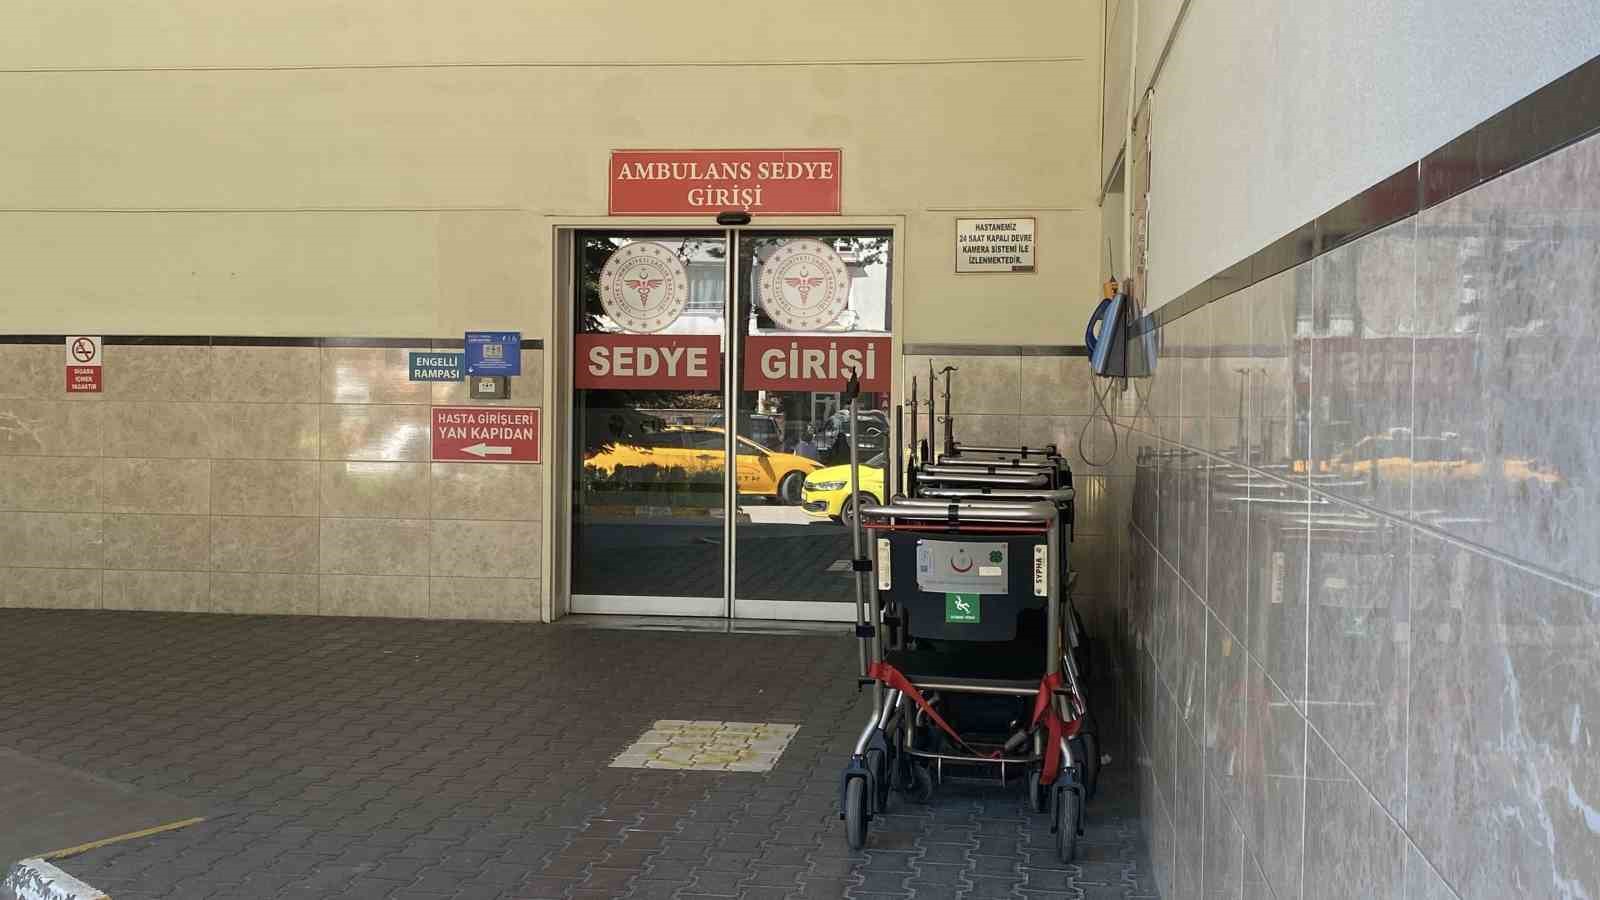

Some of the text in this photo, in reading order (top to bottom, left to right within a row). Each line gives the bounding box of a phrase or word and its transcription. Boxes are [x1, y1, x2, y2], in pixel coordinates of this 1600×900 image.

[617, 161, 833, 180] AMBULANS SEDYE
[687, 184, 763, 211] GİRİŞİ
[975, 222, 1017, 231] HASTANEMİZ
[959, 234, 1033, 242] 24 SAAT KAPALI DEVRE
[962, 243, 1030, 253] KAMERA SİSTEMİ İLE
[416, 356, 458, 367] ENGELLİ
[587, 345, 708, 377] SEDYE
[414, 369, 460, 379] RAMPASI
[438, 412, 534, 427] HASTA GİRİŞLERİ
[439, 427, 534, 441] YAN KAPIDAN
